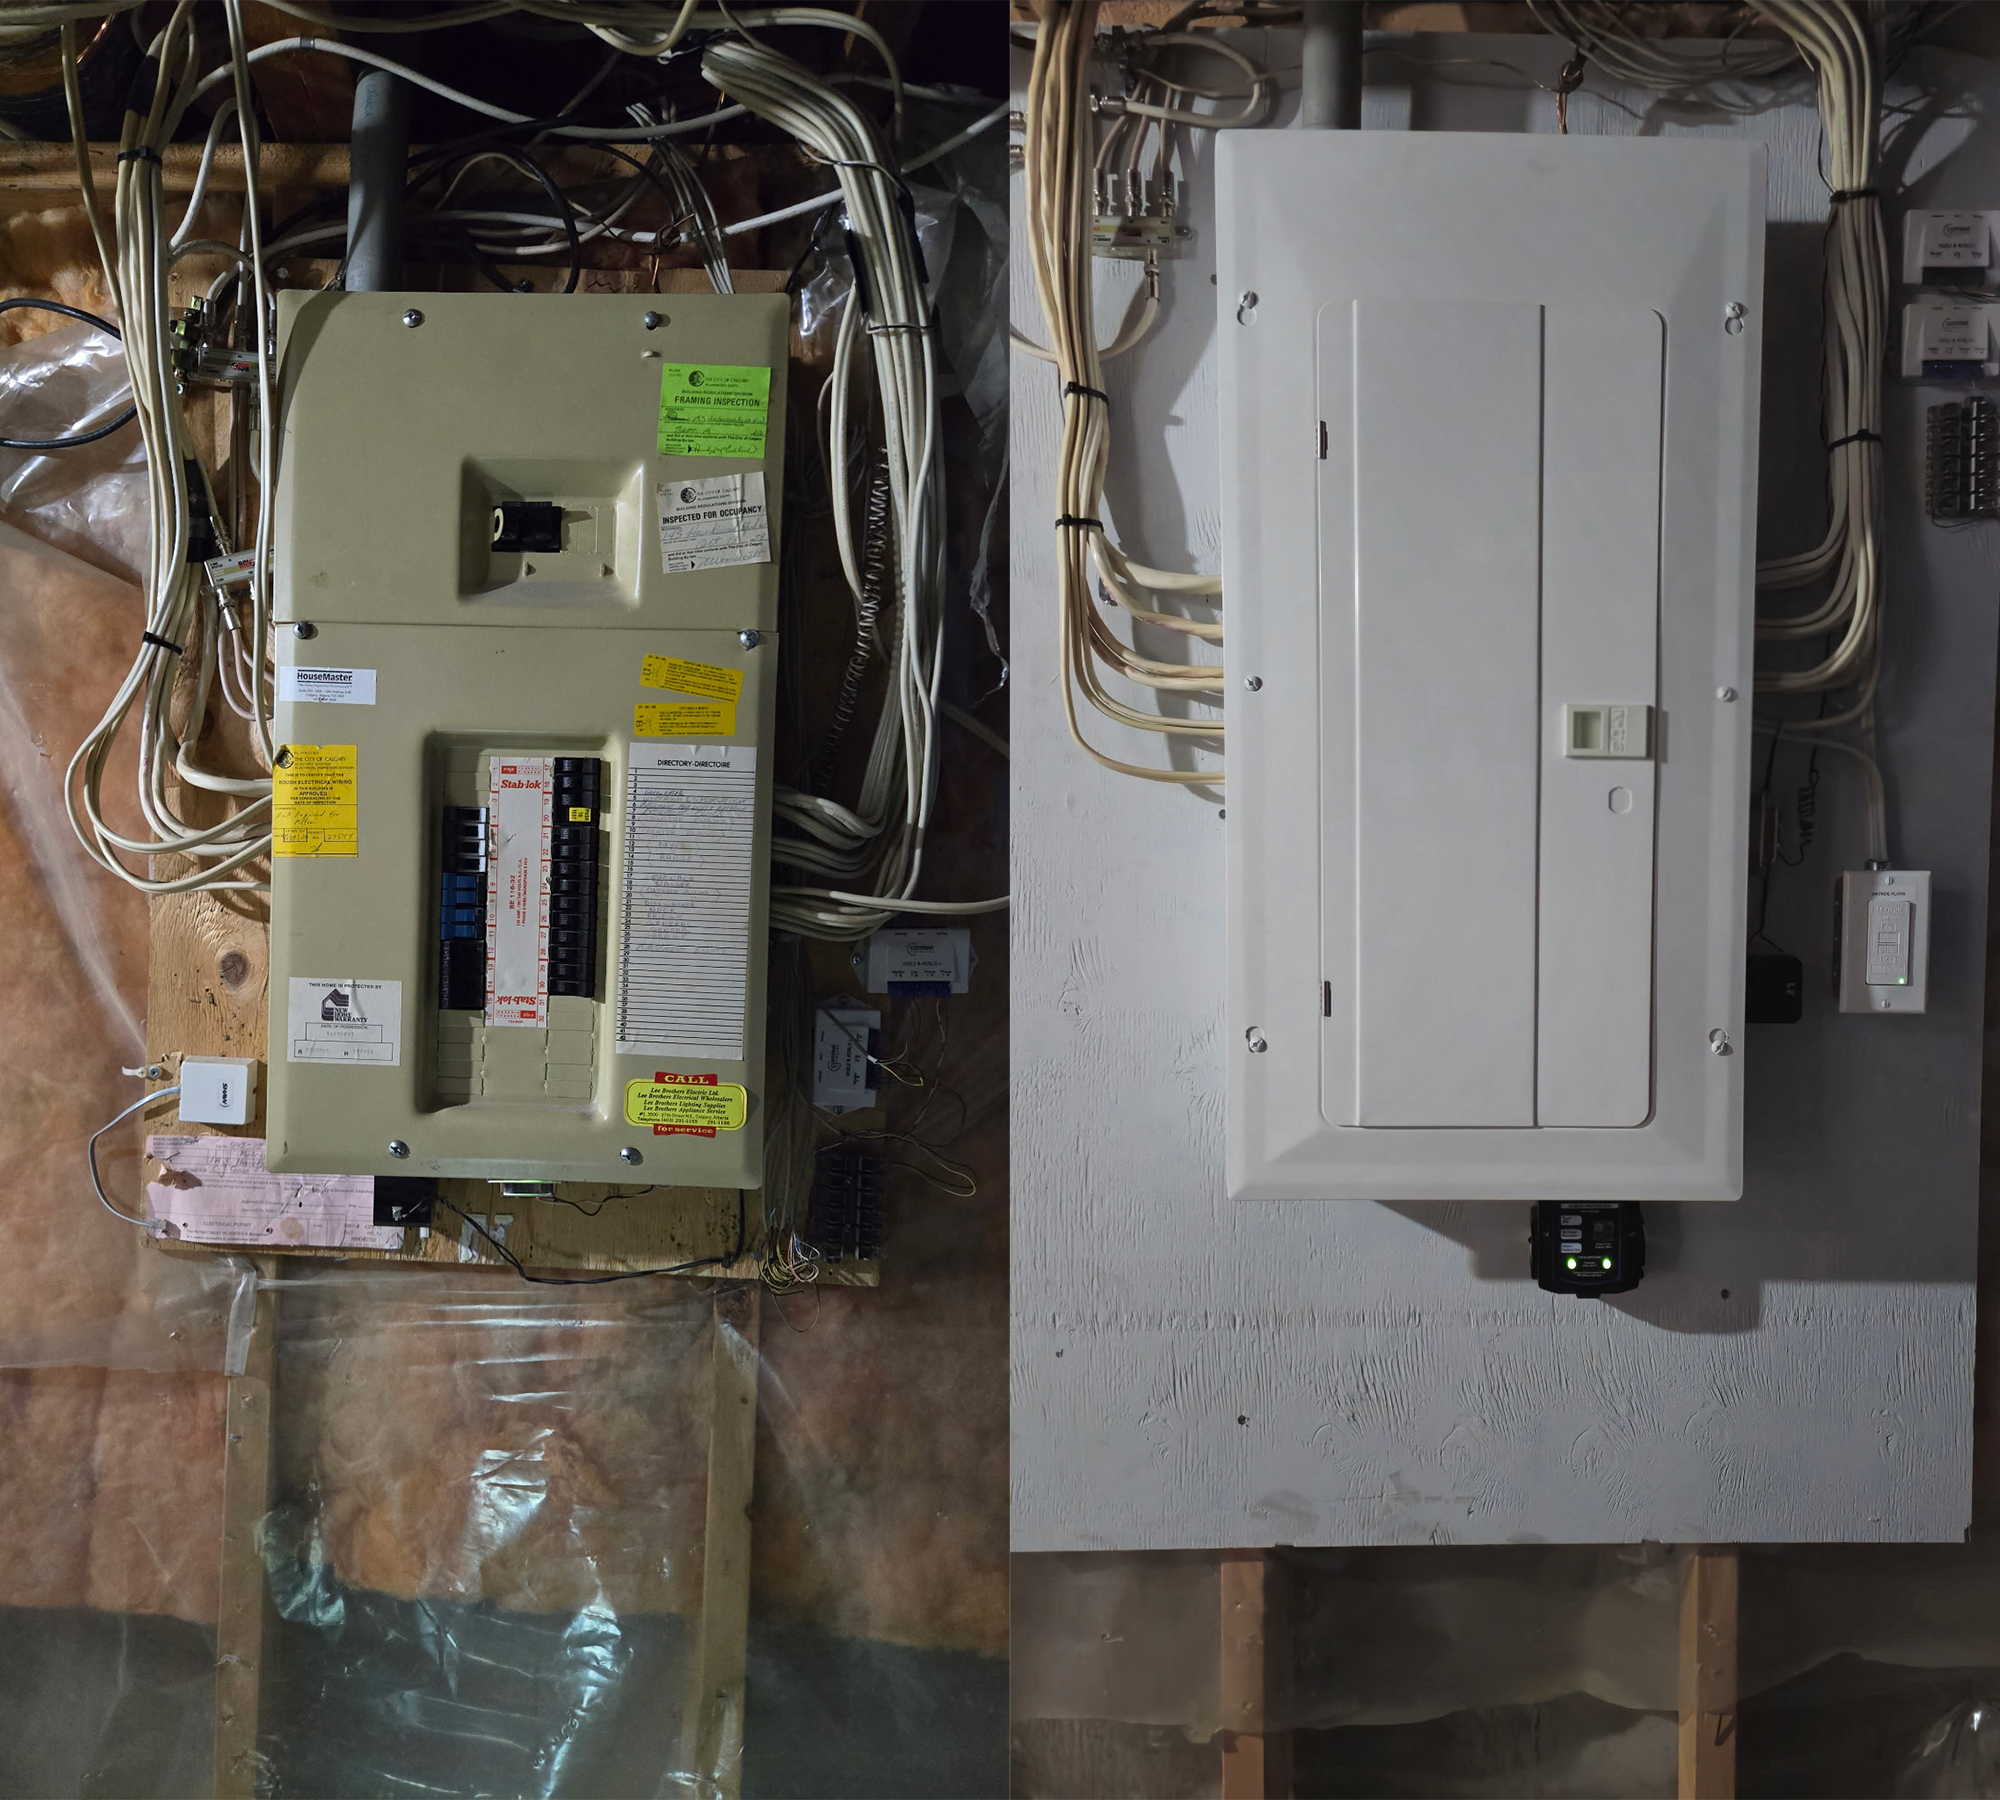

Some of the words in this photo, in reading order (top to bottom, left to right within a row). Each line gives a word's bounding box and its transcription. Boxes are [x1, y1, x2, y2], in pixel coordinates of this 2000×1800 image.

[675, 396, 711, 404] FRAMING
[714, 398, 760, 406] INSPECTION
[662, 513, 701, 524] INSPECTED
[703, 511, 717, 519] FOR
[720, 505, 762, 517] OCCUPANCY
[297, 672, 352, 681] HouseMaster
[658, 759, 730, 768] DIRECTORY-DIRECTOIRE
[544, 814, 549, 822] 20
[541, 931, 547, 939] 27
[541, 948, 546, 956] 28
[664, 1075, 709, 1084] CALL
[675, 1126, 714, 1134] service
